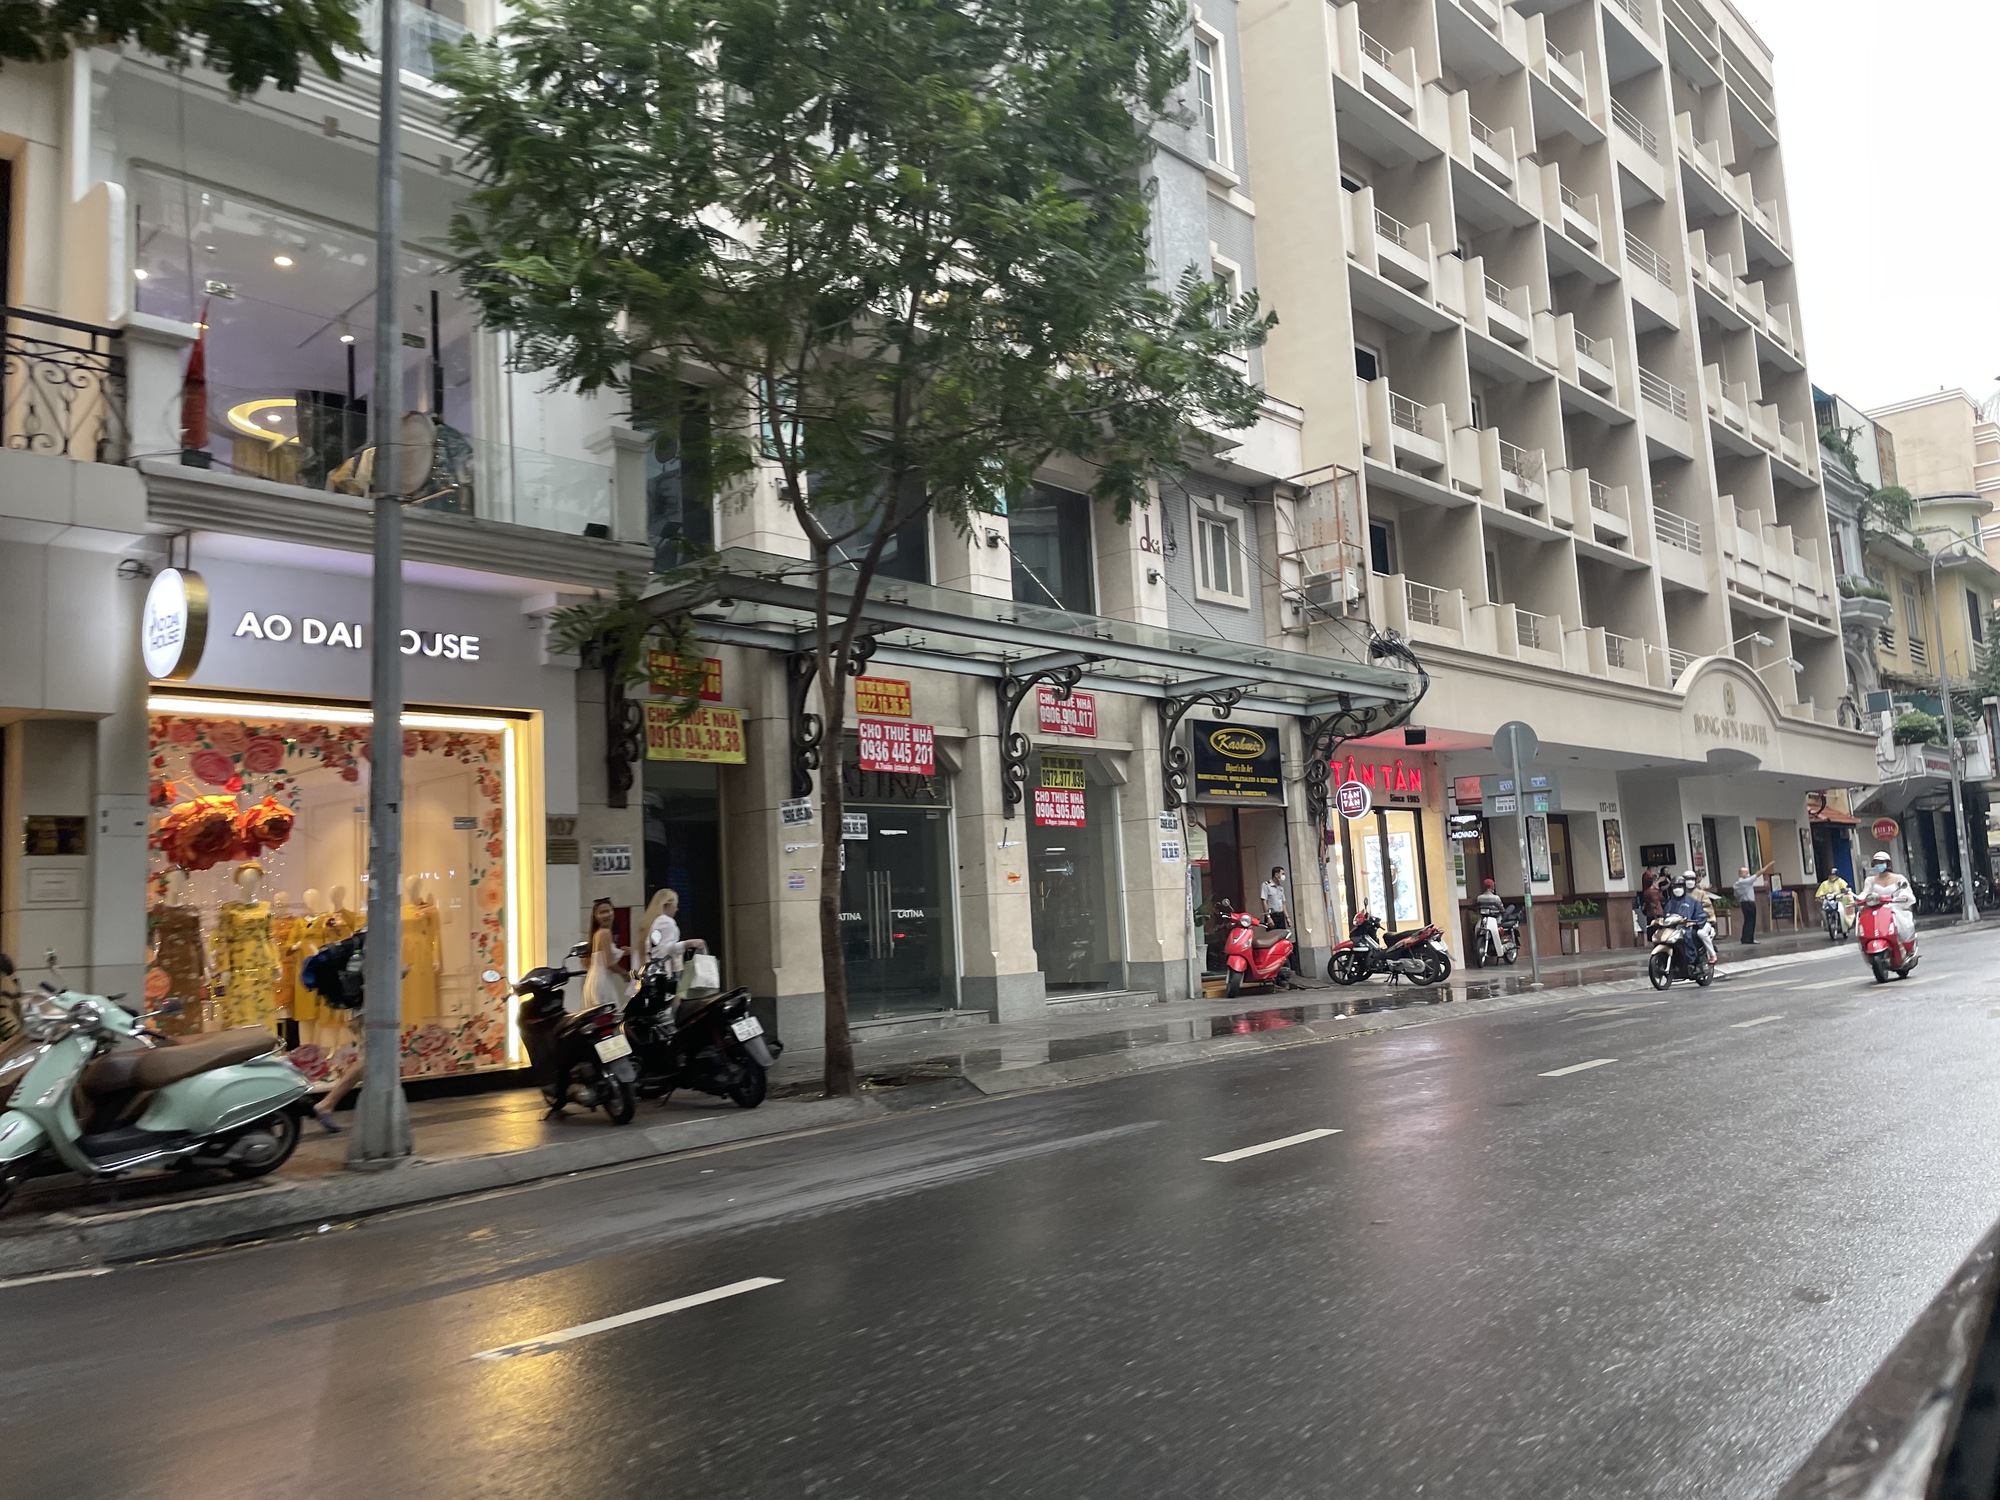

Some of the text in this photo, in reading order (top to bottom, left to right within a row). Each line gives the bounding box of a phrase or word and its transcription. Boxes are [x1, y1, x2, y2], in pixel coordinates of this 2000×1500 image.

[233, 611, 480, 660] AO DAI OUSE
[1076, 697, 1092, 710] NHÀ
[648, 706, 673, 723] CHO
[713, 711, 739, 729] NHÀ
[1040, 705, 1093, 728] 0906.900.017
[860, 722, 934, 744] CHO THUÊ NHÀ
[1217, 733, 1261, 753] Kashmir
[861, 738, 933, 765] 0936 445 201
[1042, 769, 1085, 787] 0972.377.039
[1330, 755, 1422, 792] TÂN TÂN
[1035, 790, 1084, 805] CHO THUÊ NHÀ
[1035, 802, 1085, 820] 0906.905.006
[1452, 830, 1479, 840] MOVADO
[838, 913, 862, 921] ATINA
